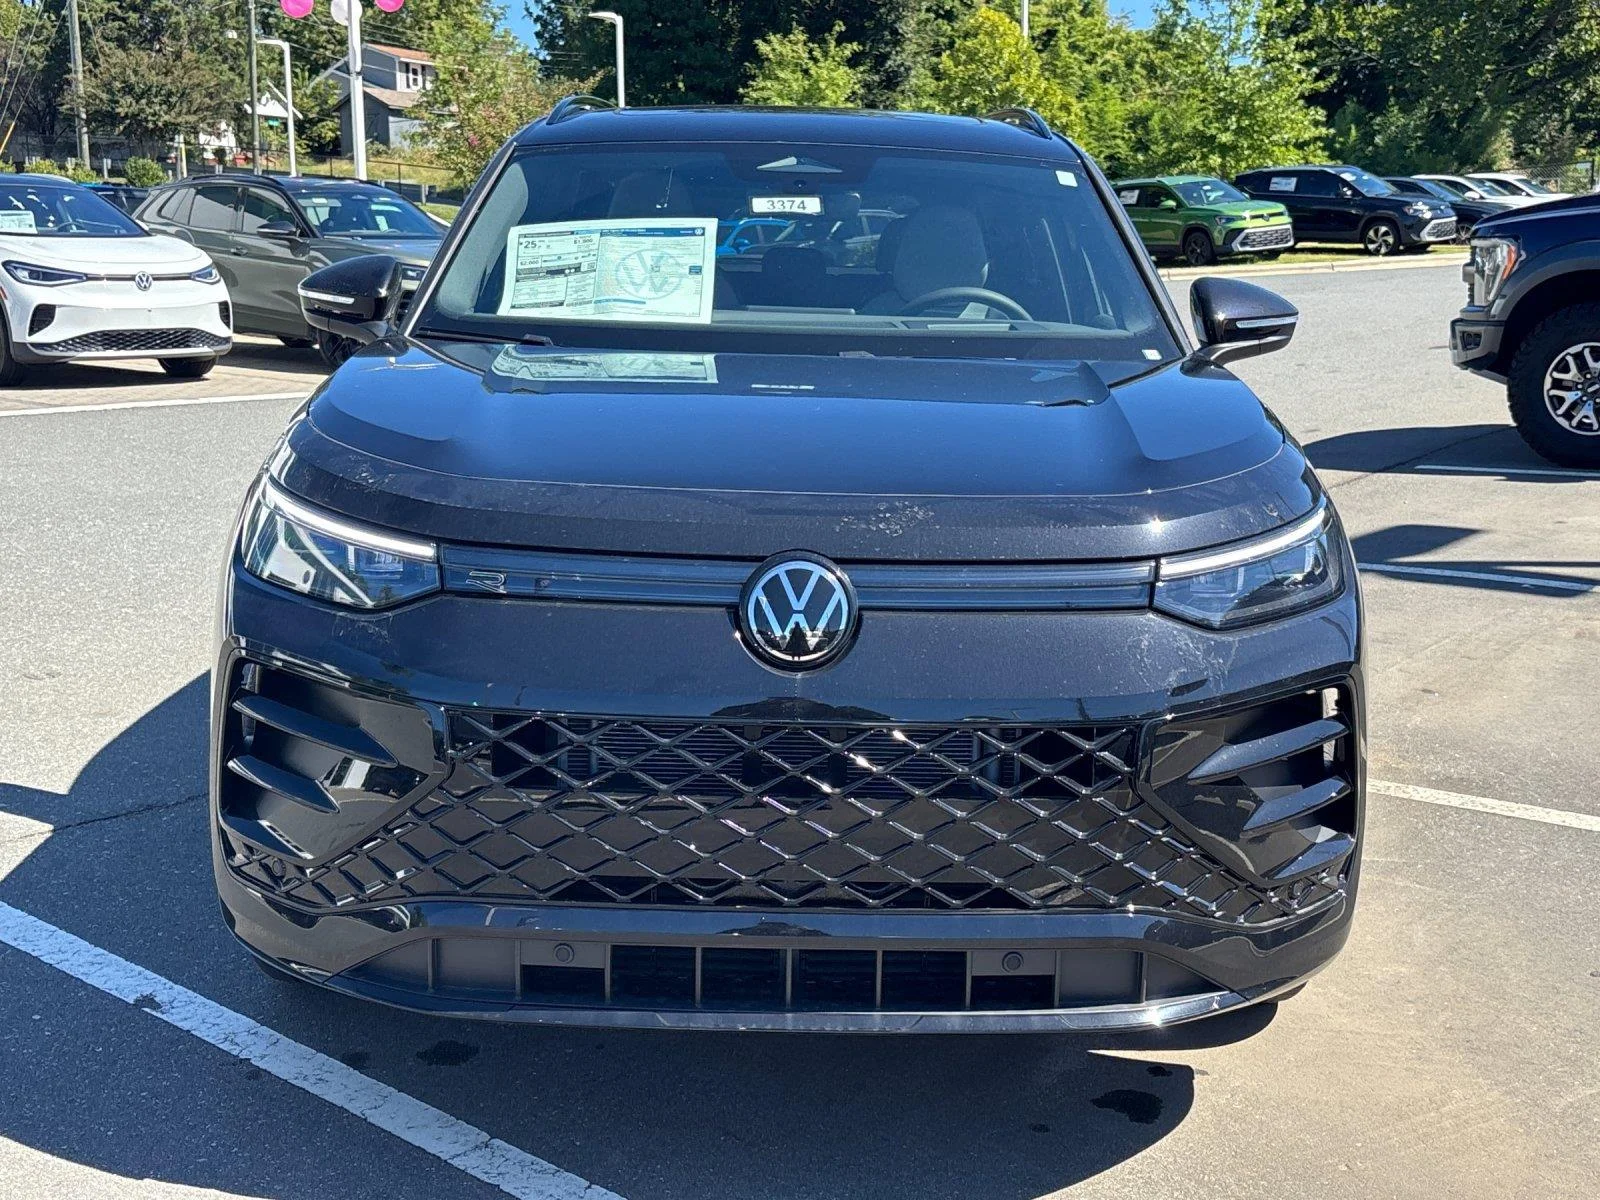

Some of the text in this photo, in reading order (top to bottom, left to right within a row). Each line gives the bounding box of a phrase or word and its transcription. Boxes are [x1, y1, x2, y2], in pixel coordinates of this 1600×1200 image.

[766, 199, 807, 211] 3374
[523, 240, 537, 249] 25
[465, 570, 507, 594] R
[747, 560, 849, 661] VW
